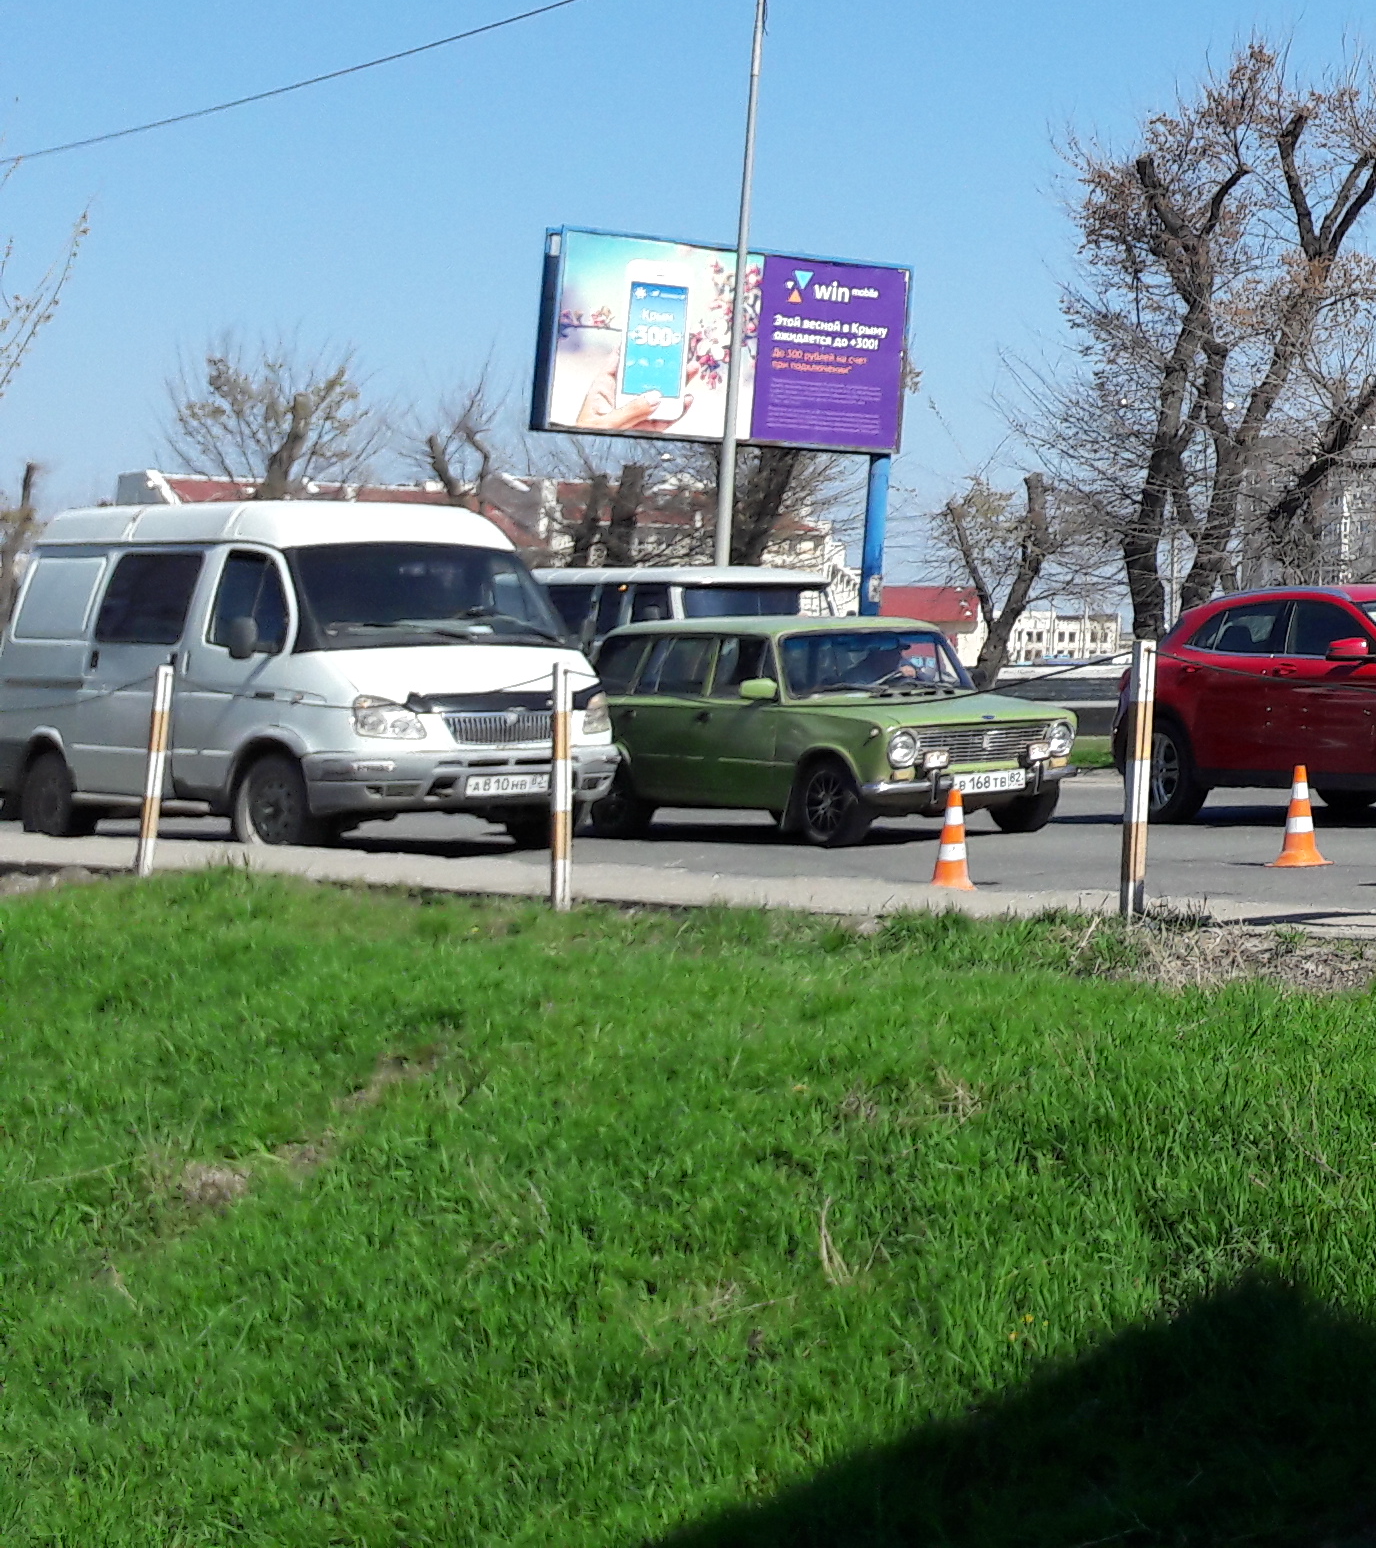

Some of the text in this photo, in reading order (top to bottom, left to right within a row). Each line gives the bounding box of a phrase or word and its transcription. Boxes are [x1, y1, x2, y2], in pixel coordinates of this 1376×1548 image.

[814, 280, 850, 303] win
[773, 314, 801, 328] Этой
[803, 319, 841, 332] весной
[851, 322, 888, 339] Крыму
